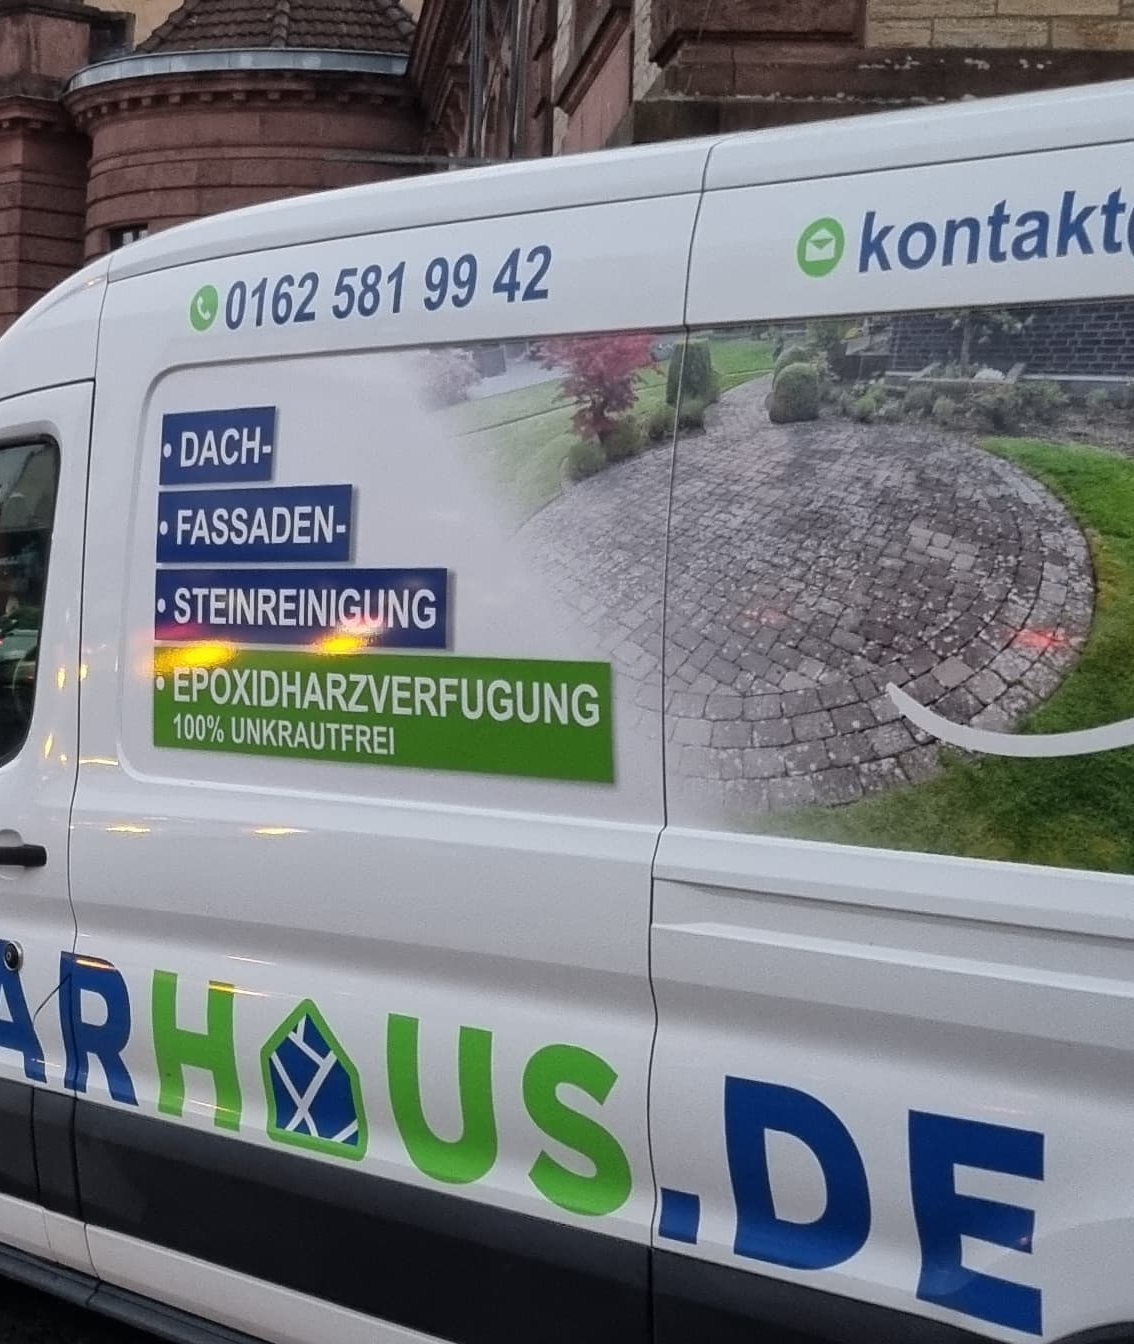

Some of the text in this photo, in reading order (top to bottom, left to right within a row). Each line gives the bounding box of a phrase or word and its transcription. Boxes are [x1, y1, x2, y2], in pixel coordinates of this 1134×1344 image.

[858, 186, 1134, 274] kontakt
[225, 244, 552, 331] 0162 581 99 42
[179, 426, 272, 468] DACH-
[175, 505, 346, 546] FASSADEN-
[173, 586, 437, 630] STEINREINIGUNG
[172, 666, 601, 728] EPOXIDHARZVERFUGUNG
[173, 712, 396, 756] 100% UNKRAUTFREI
